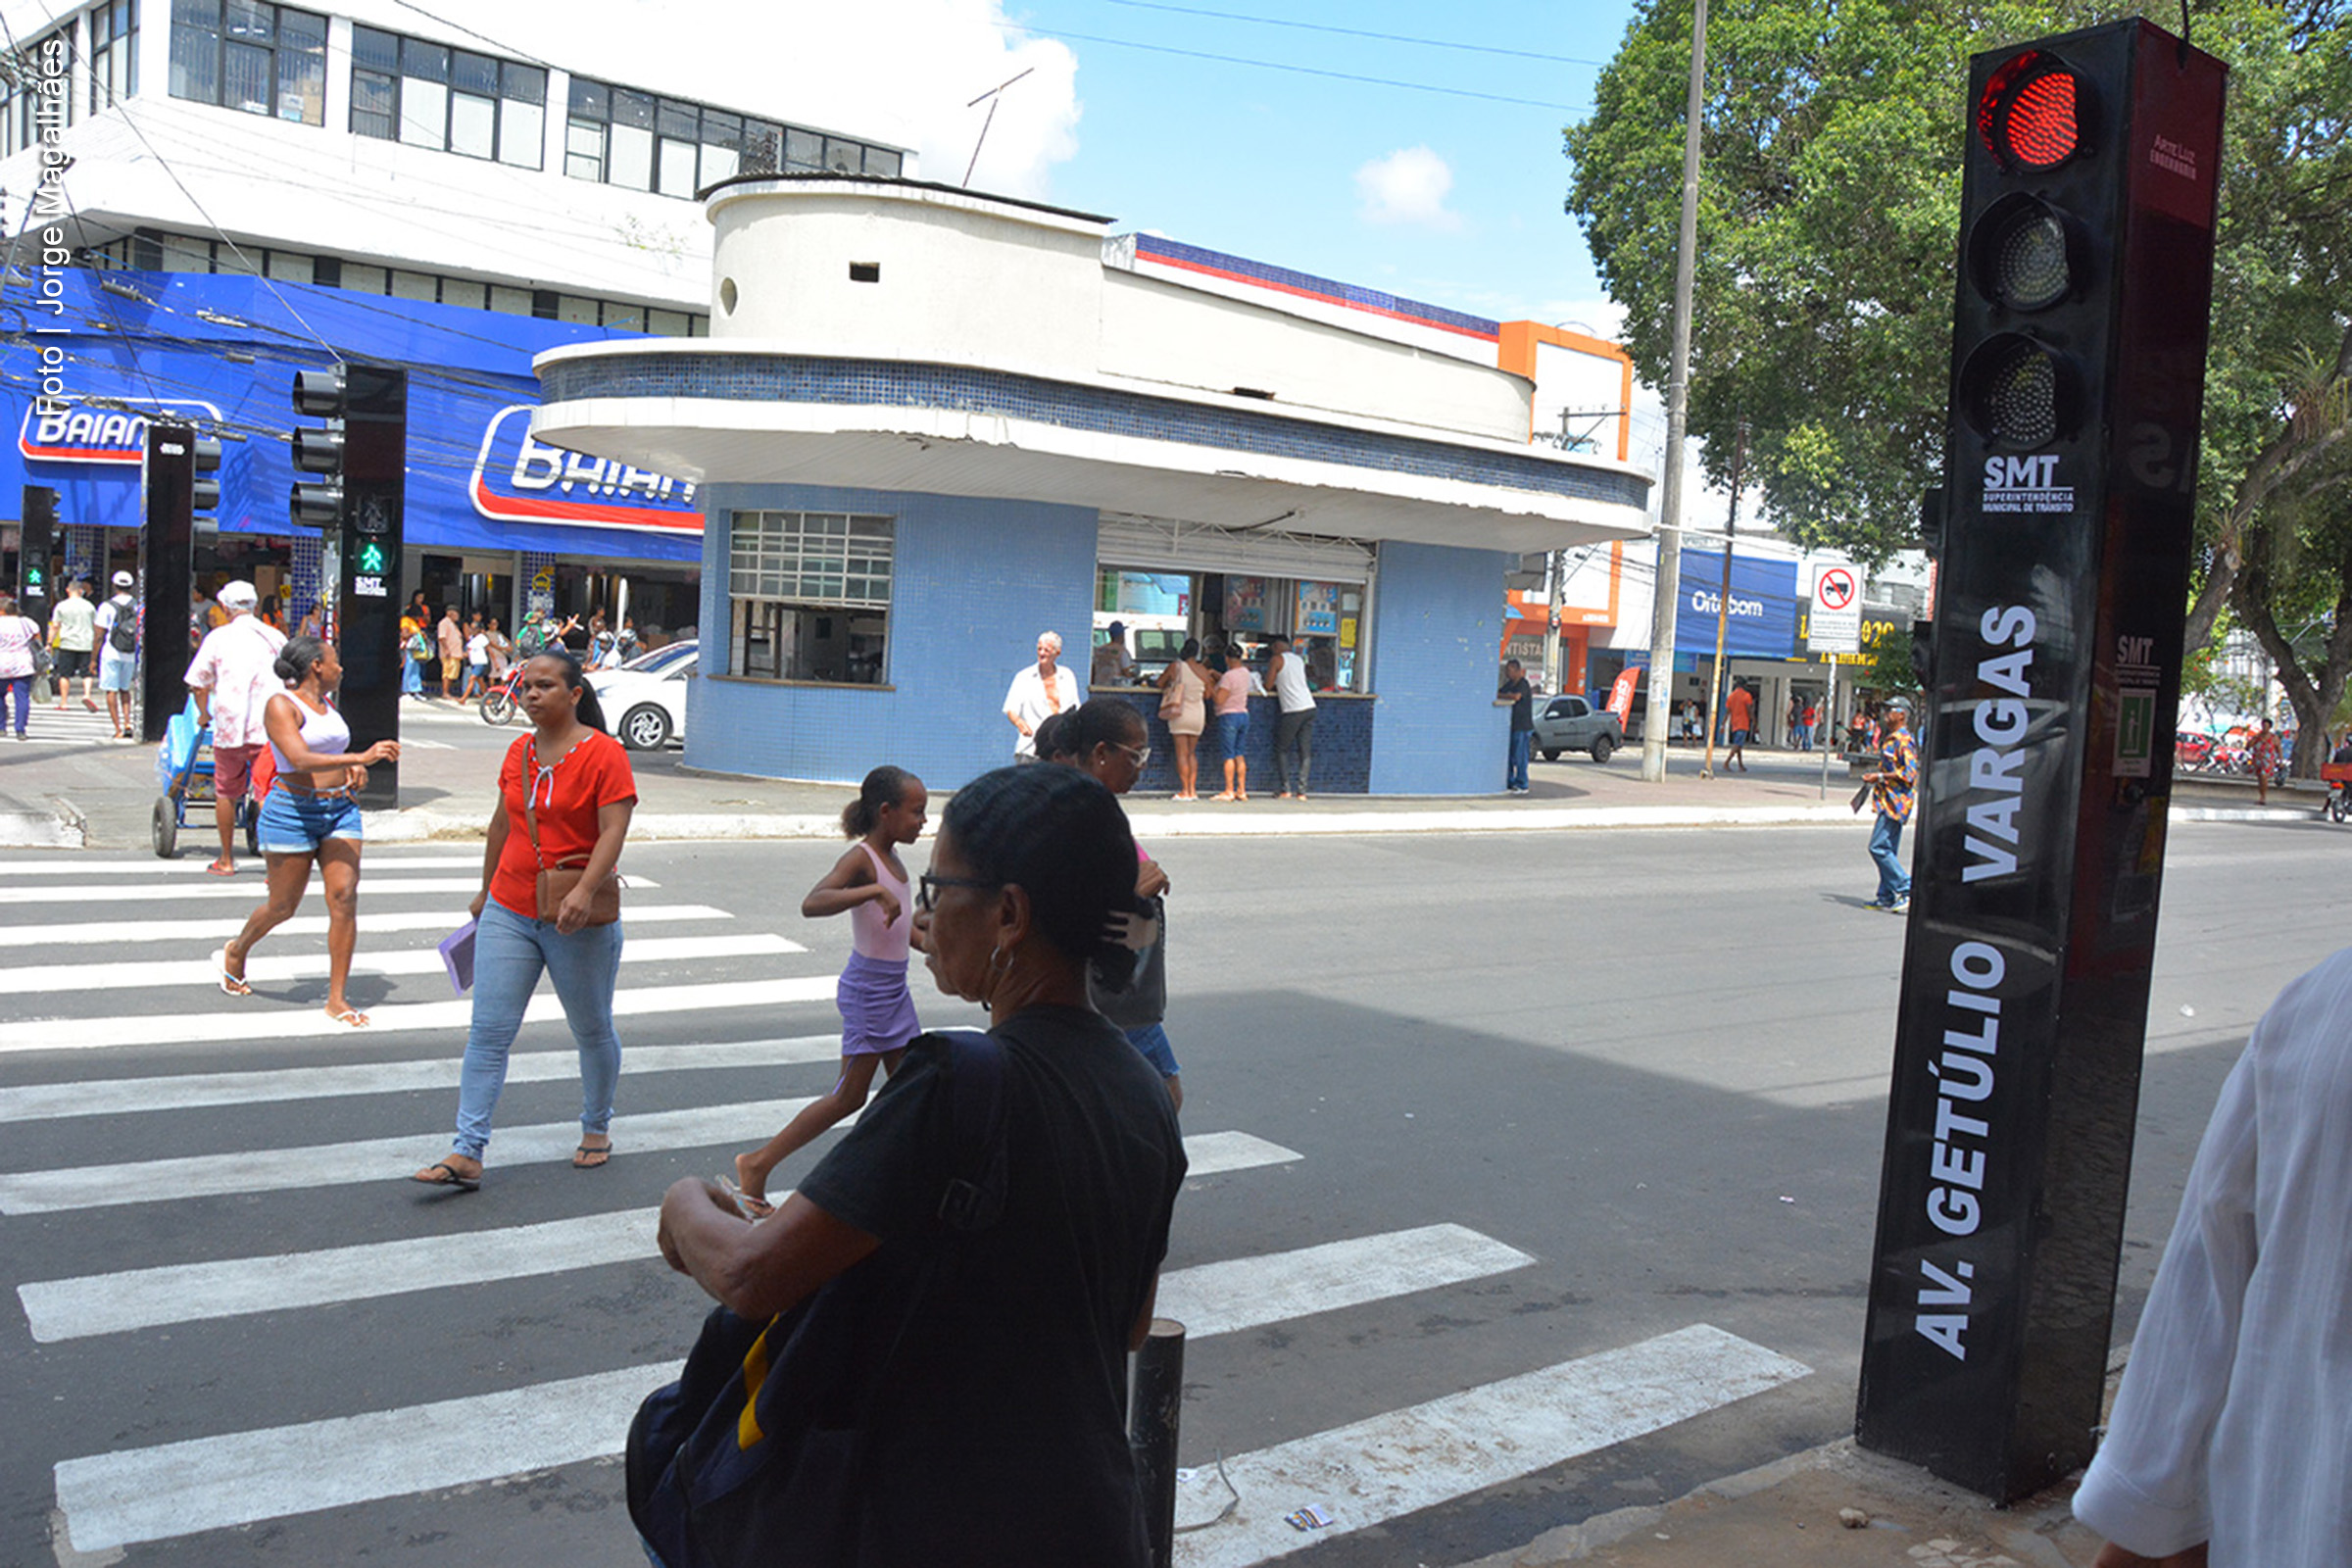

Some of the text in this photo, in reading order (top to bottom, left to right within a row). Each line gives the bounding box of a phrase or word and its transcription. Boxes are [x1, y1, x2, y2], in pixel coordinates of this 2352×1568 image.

[1984, 456, 2059, 488] SMT
[1983, 491, 2074, 502] SUPERINTENDÊNCIA
[1983, 503, 2021, 513] MUNICIPAL
[2023, 503, 2033, 513] DE
[2117, 635, 2153, 664] SMT
[1915, 606, 2036, 1361] AV. GETÚLIO VARGAS
